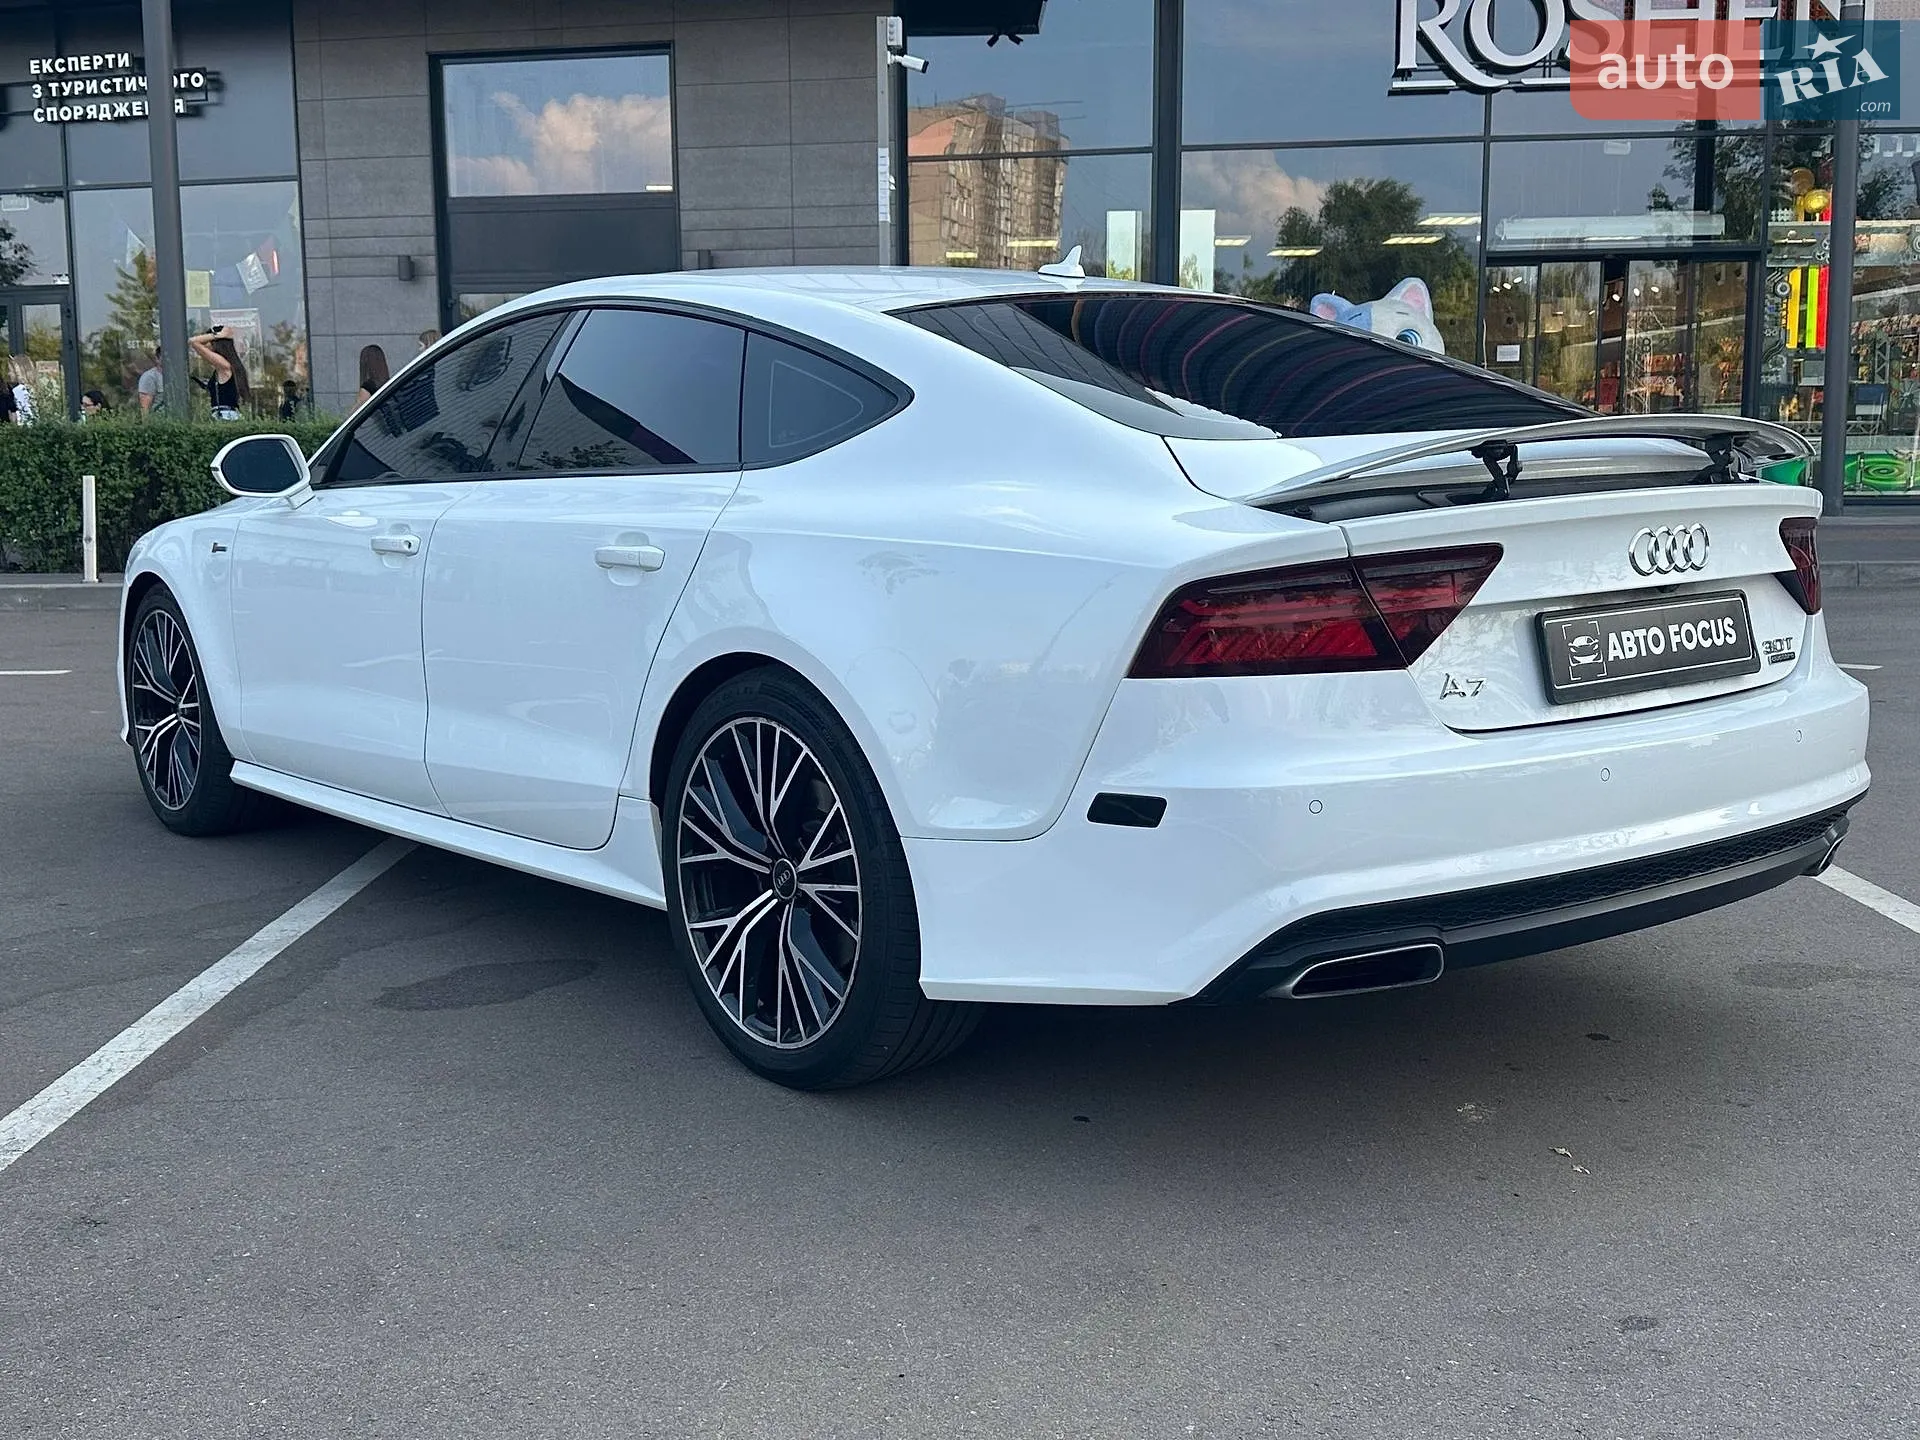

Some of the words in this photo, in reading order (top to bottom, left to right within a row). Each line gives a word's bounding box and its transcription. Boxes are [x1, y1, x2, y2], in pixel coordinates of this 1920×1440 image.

[29, 52, 130, 75] ЕКСПЕРТИ
[48, 72, 204, 97] ТУРИСТИЧГО
[33, 98, 184, 123] СПОРЯДЖЕЯ
[1668, 616, 1737, 652] FOCUS
[1440, 672, 1486, 700] A7
